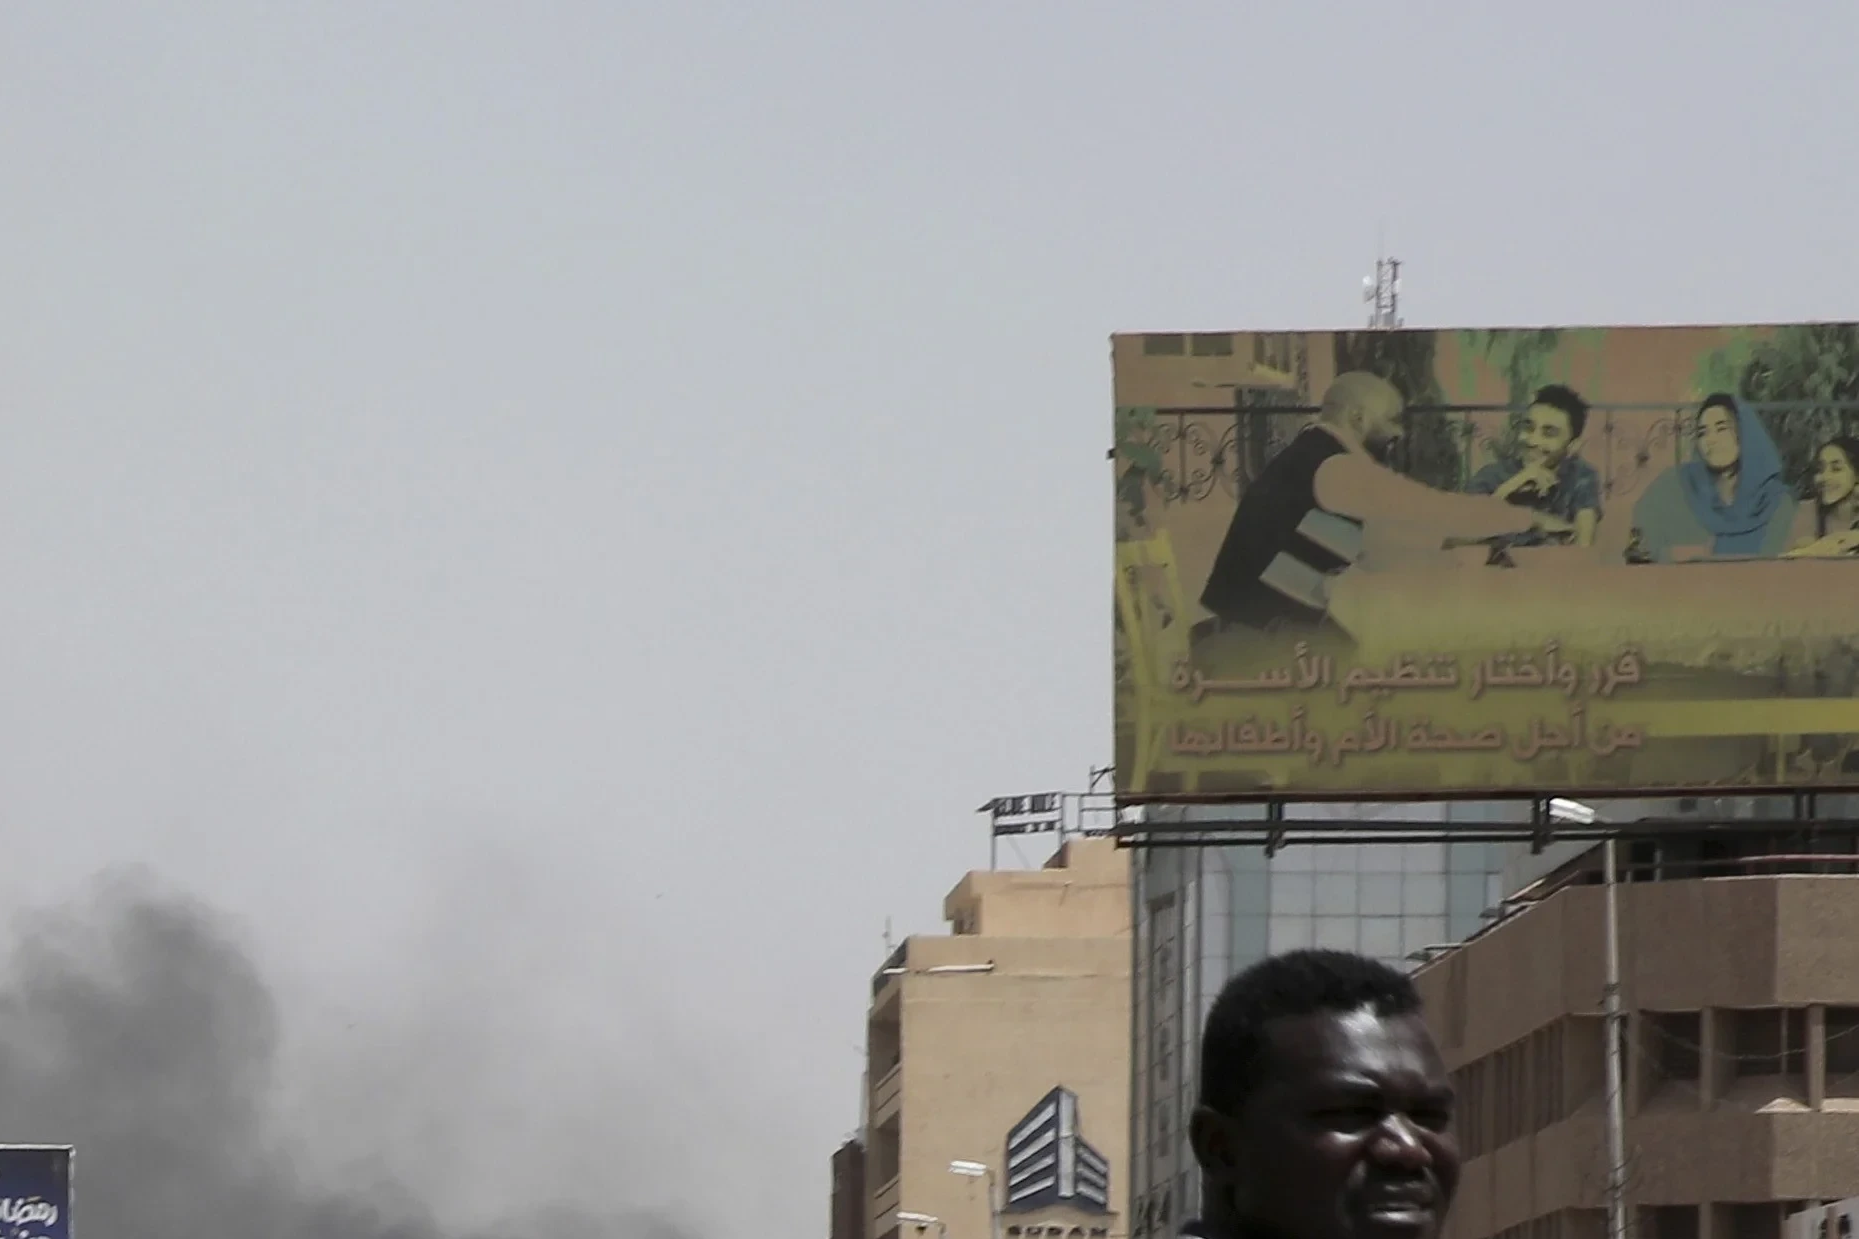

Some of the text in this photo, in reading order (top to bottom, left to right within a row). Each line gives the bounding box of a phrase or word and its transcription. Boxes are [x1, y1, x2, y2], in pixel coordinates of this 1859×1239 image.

[1338, 652, 1459, 701] تنظيم
[1584, 647, 1640, 696] قرر
[1332, 710, 1398, 764] الأم
[1406, 721, 1502, 752] صحة
[1512, 703, 1585, 760] أجل
[1591, 724, 1641, 755] من
